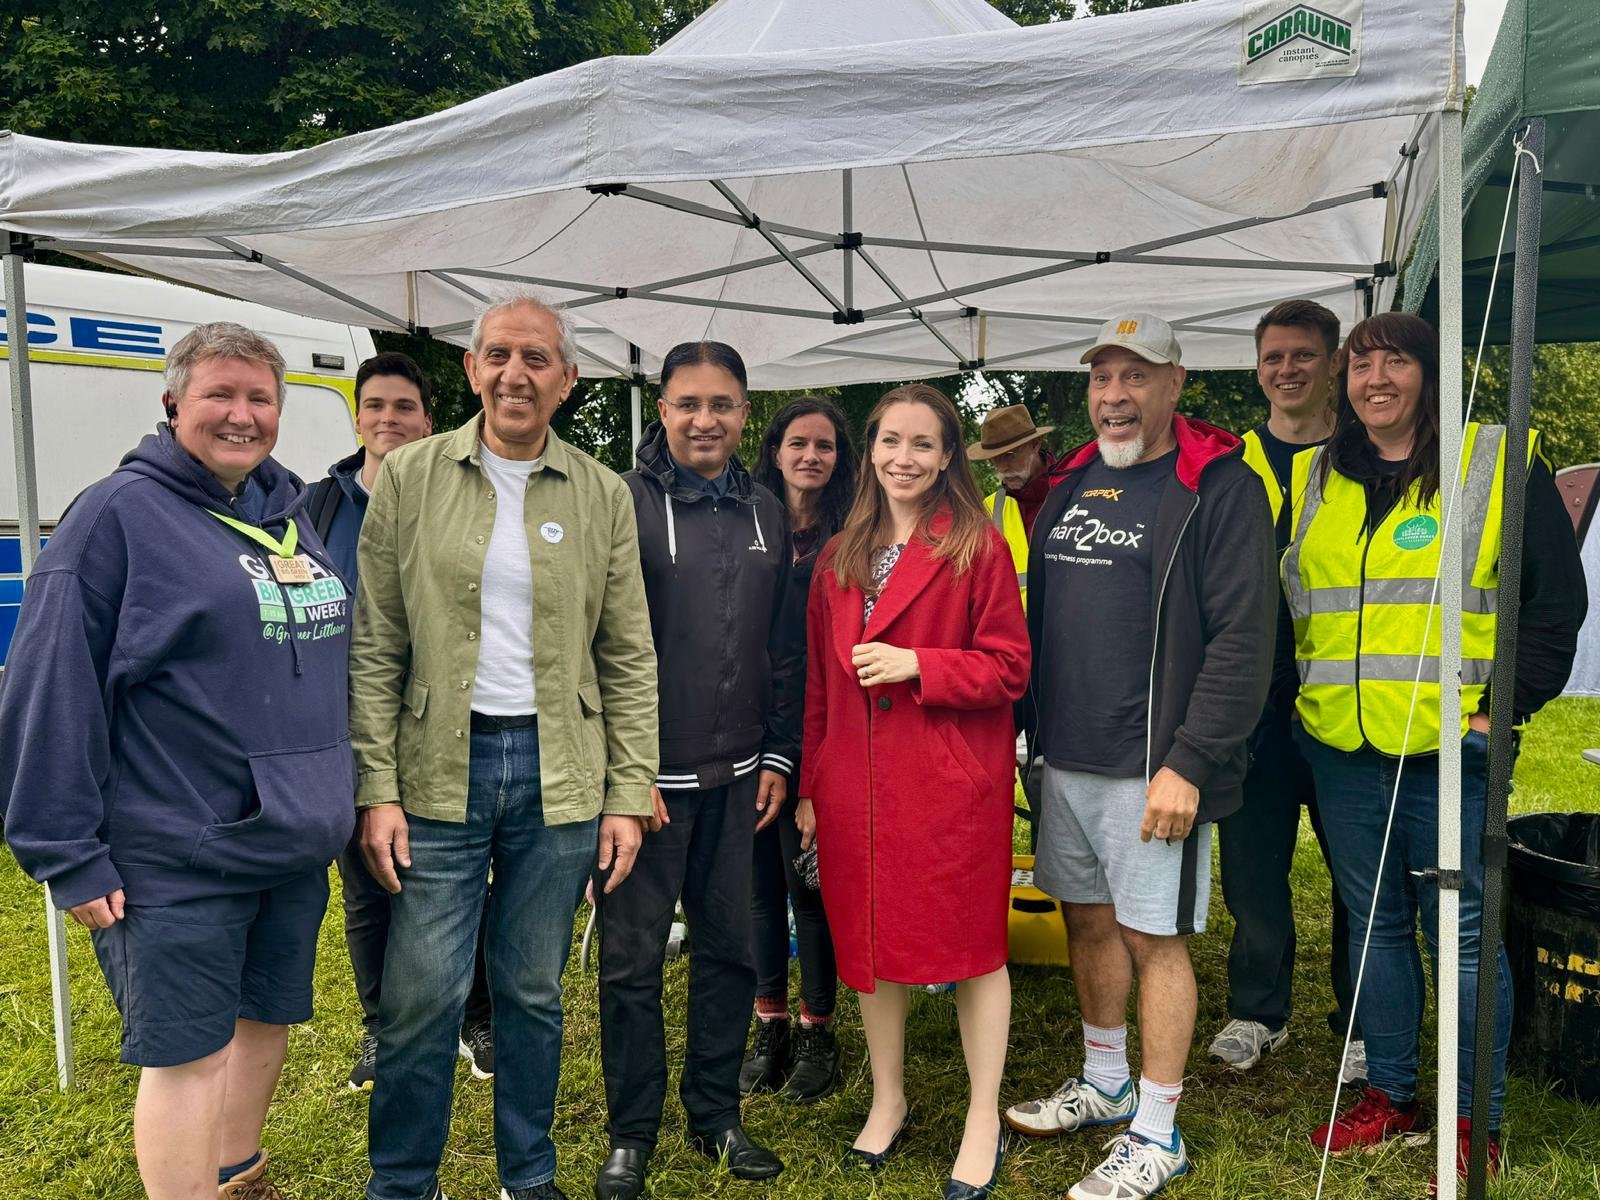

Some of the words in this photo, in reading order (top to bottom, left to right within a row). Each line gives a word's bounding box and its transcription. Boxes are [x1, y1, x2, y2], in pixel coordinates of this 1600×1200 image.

[1247, 9, 1351, 58] CARAVAN
[1278, 53, 1319, 62] canopies
[1283, 47, 1315, 56] instant
[279, 560, 306, 569] GREAT
[1058, 553, 1076, 563] fitness
[1076, 557, 1113, 566] programme
[288, 580, 345, 604] GREEN
[306, 602, 341, 621] WEEK
